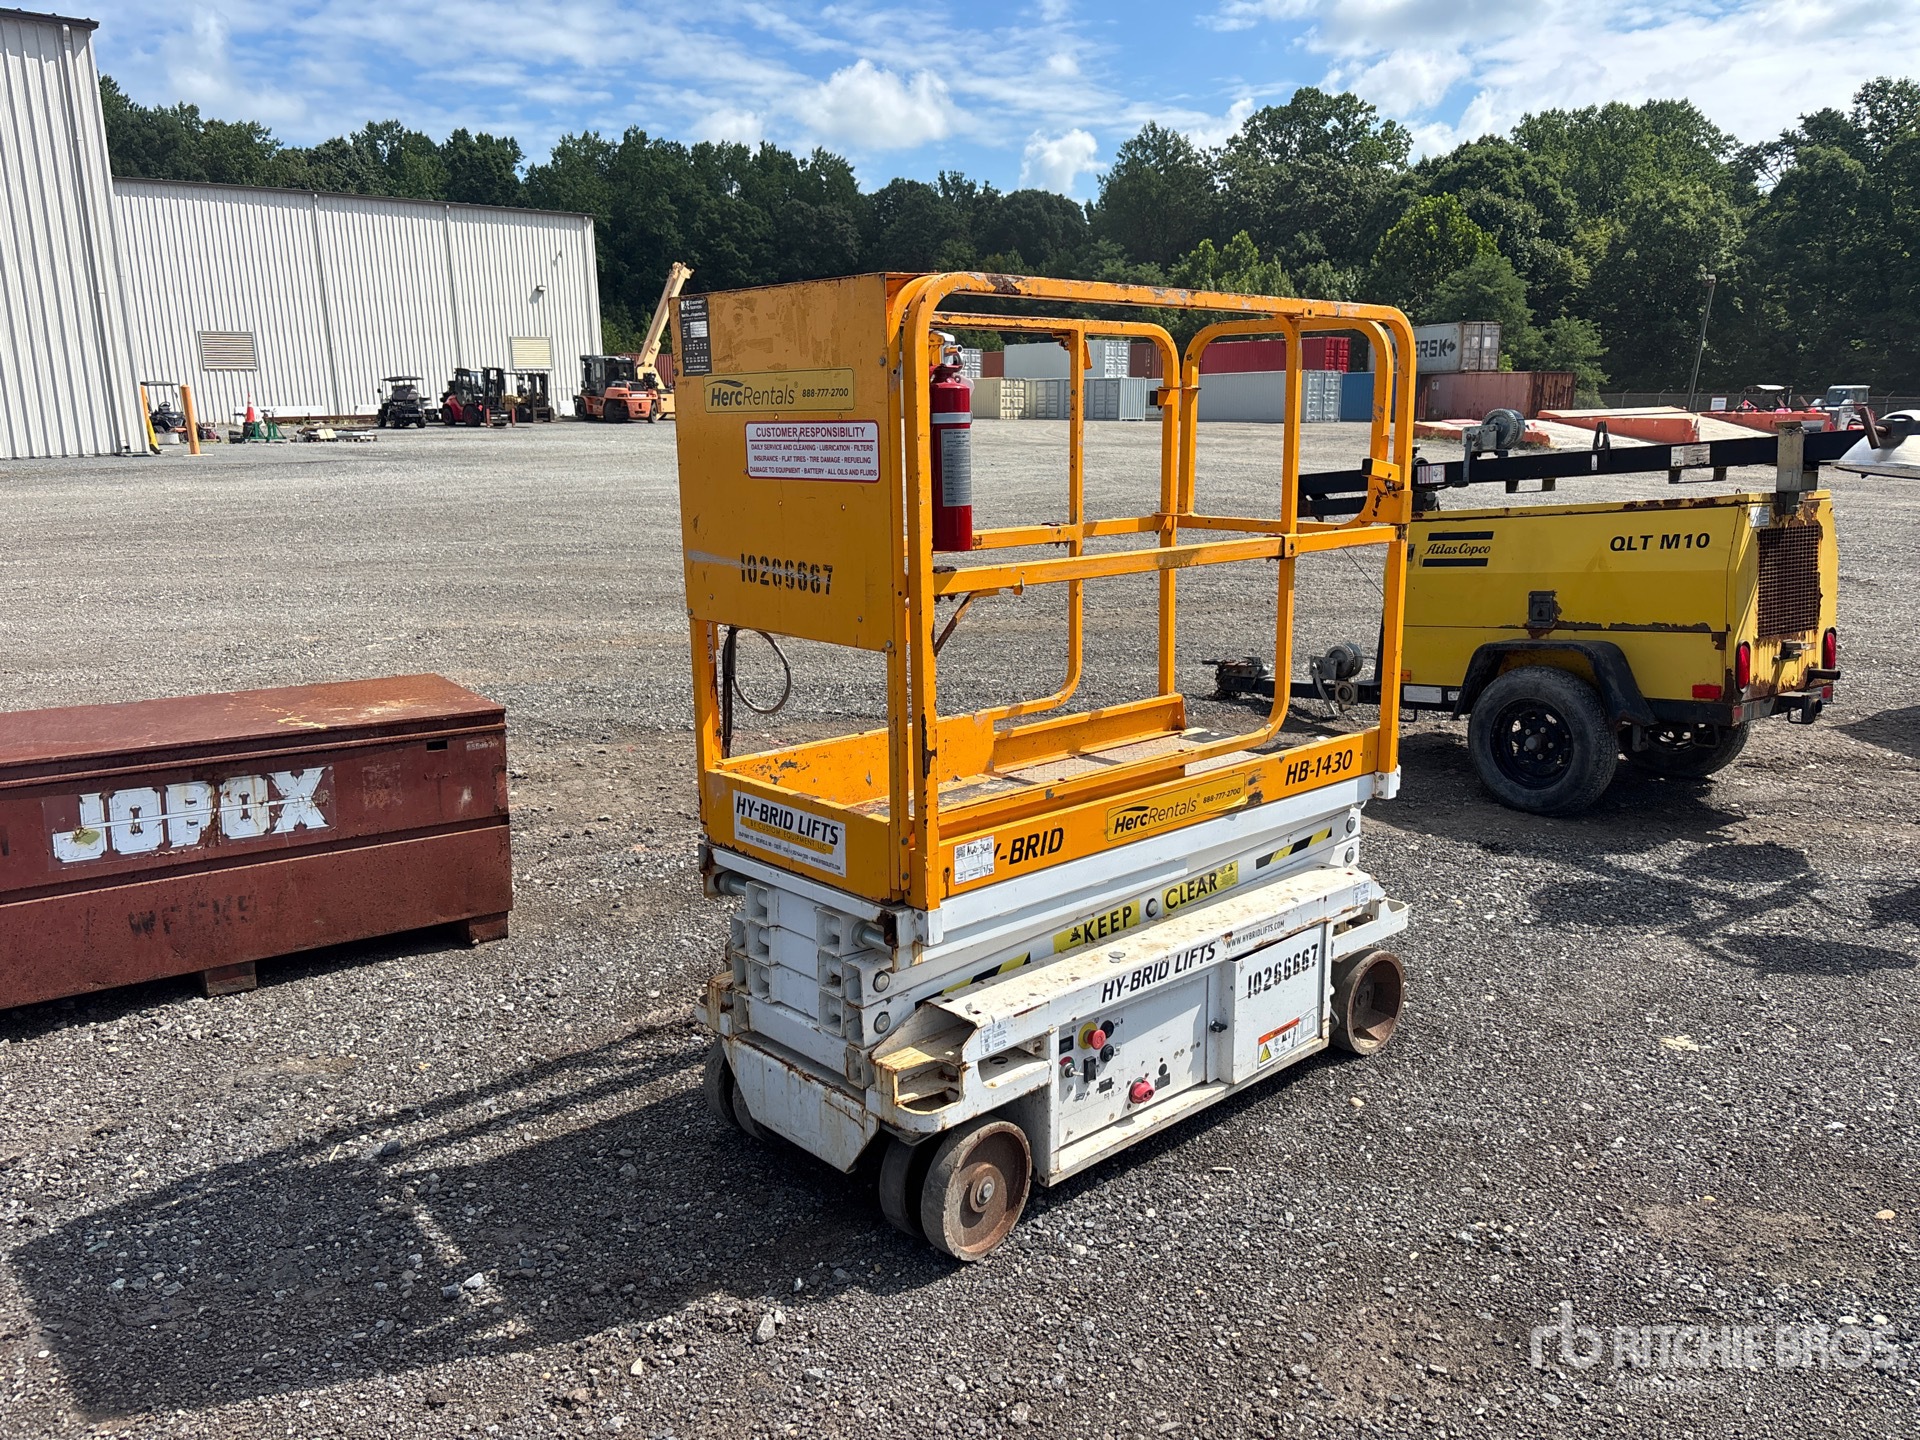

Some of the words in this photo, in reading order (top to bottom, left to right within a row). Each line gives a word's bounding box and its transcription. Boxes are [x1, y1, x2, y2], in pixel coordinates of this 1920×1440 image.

[802, 388, 849, 398] 888-777-2700
[756, 427, 798, 438] CUSTOMER
[799, 427, 866, 438] RESPONSIBILITY
[819, 444, 850, 452] LUBRICATION
[838, 468, 848, 476] OILS
[1425, 543, 1458, 555] Atlas
[1458, 543, 1491, 556] Copco
[1610, 535, 1654, 552] QLT
[1660, 532, 1711, 549] M10
[740, 553, 834, 595] 10266667
[1285, 749, 1353, 786] HB-1430
[1203, 787, 1242, 804] 888-777-2700
[52, 766, 330, 863] JOBOX
[736, 796, 794, 831] HY-BRID
[798, 815, 839, 846] LIFTS
[758, 822, 781, 835] CUSTOM
[783, 830, 816, 848] EQUIPMENT
[994, 827, 1065, 866] -BRID
[1082, 905, 1132, 943] KEEP
[1165, 872, 1218, 910] CLEAR
[1101, 960, 1170, 1004] HY-BRID
[1174, 941, 1216, 974] LIFTS
[1247, 943, 1319, 999] 10266667
